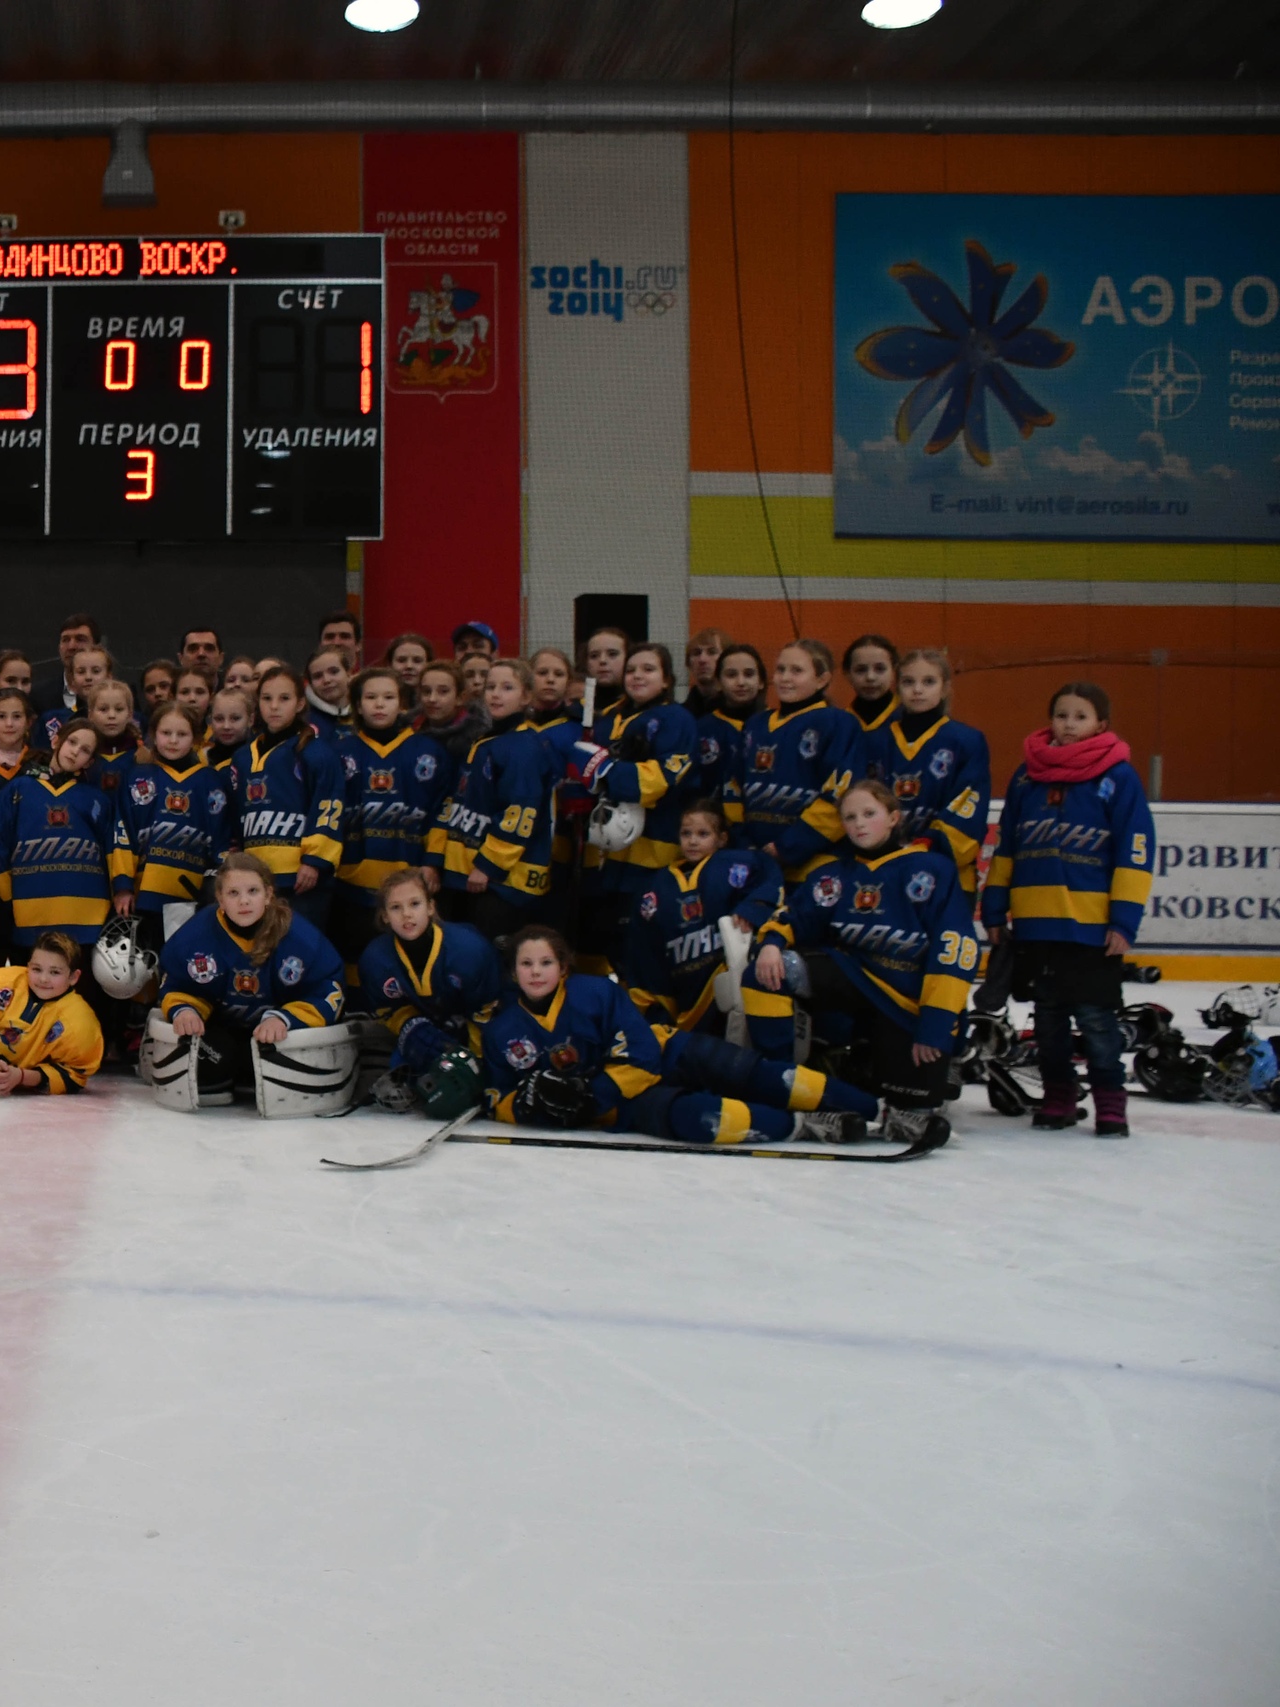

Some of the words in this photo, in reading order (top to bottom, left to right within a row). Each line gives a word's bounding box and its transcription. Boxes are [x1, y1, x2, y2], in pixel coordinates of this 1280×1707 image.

[376, 211, 507, 223] ПРАВИТЕЛЬСТВО
[384, 224, 499, 239] МОСКОВСКОЙ
[140, 242, 239, 276] ВОСКР.
[404, 243, 480, 255] ОБЛАСТИ
[277, 288, 344, 310] СЧЁТ
[548, 291, 624, 322] 2014
[1081, 275, 1279, 327] АЭРО
[87, 316, 186, 339] ВРЕМЯ
[361, 321, 373, 414] 1
[78, 422, 201, 448] ПЕРИОД
[242, 427, 378, 450] УДАЛЕНИЯ
[125, 450, 155, 500] 3
[930, 493, 1007, 513] E-mail:
[1016, 494, 1190, 516] vint@aerosila.ru
[315, 799, 344, 831] 22
[499, 804, 537, 838] 86
[1130, 832, 1147, 865] 5
[1143, 895, 1280, 920] ковск
[937, 929, 978, 971] 38
[881, 1082, 931, 1097] EASTON
